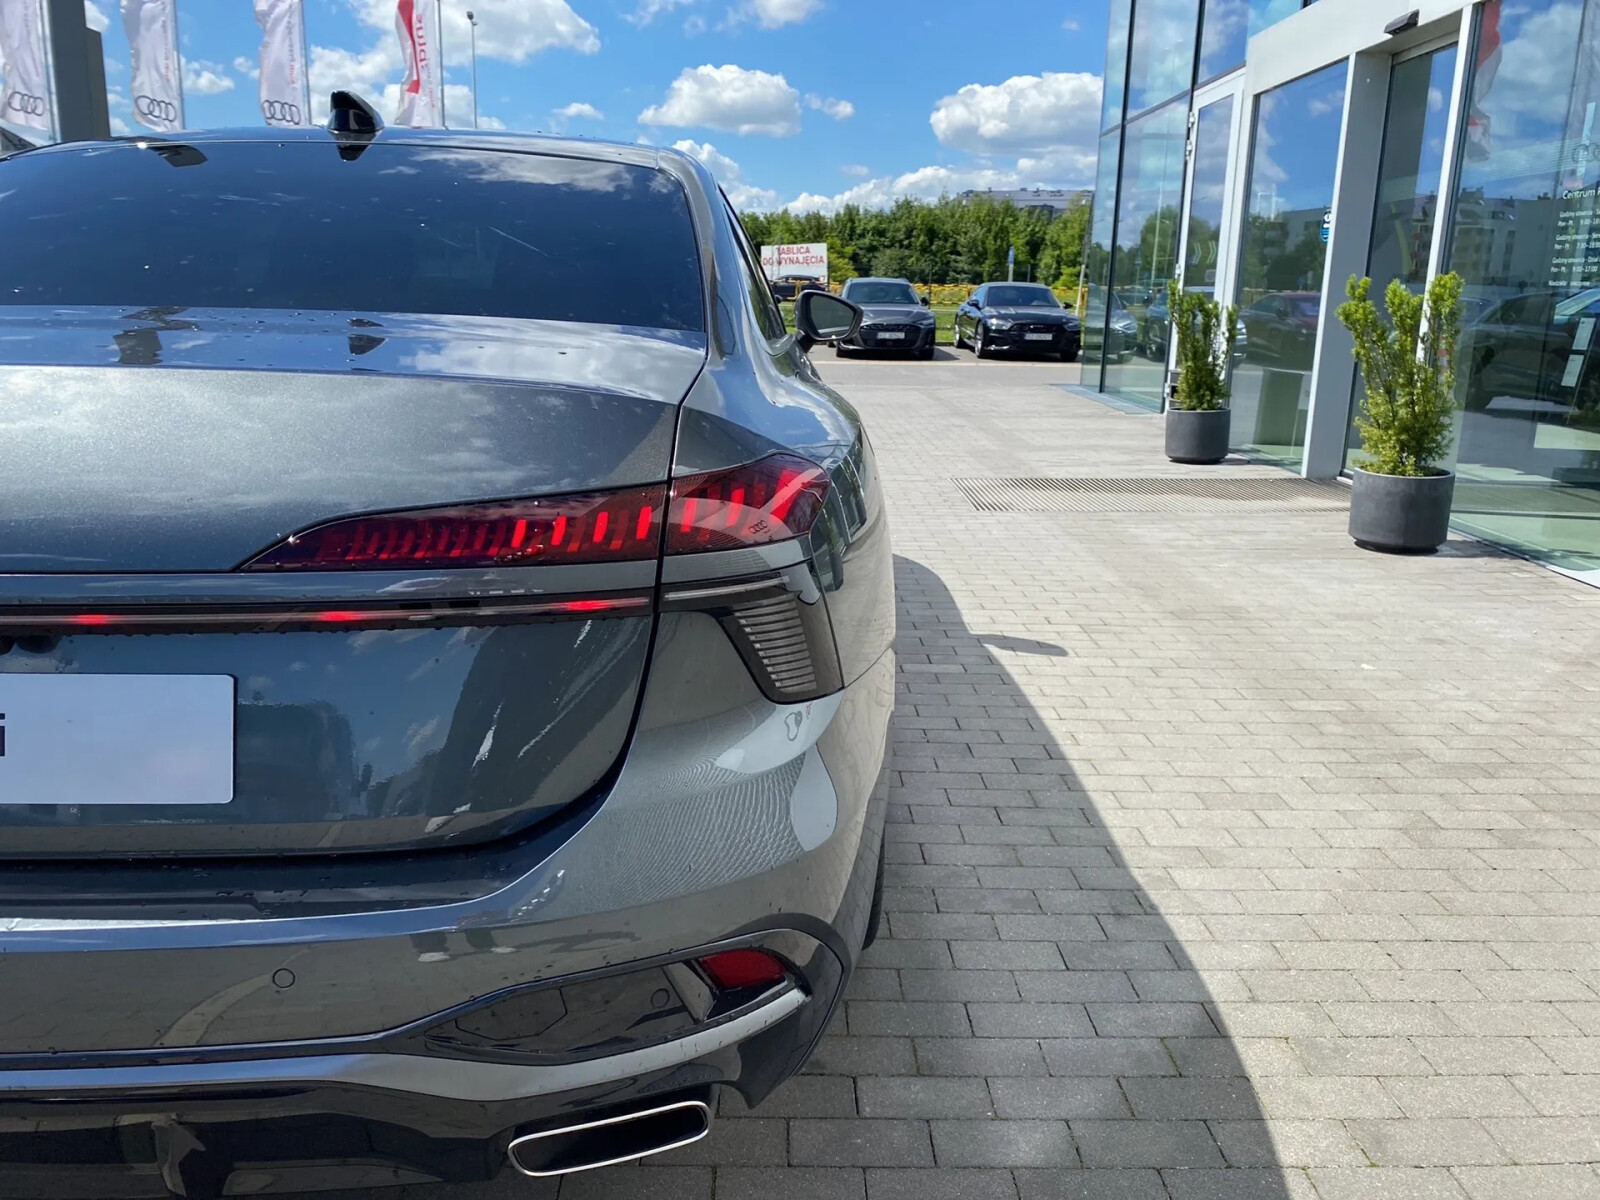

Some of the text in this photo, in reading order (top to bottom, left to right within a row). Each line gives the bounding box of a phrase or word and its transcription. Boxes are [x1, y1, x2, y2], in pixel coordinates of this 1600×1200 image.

[1562, 189, 1596, 200] Centrum
[775, 246, 811, 255] TABLICA
[763, 255, 825, 267] DO WYNAJĘCIA
